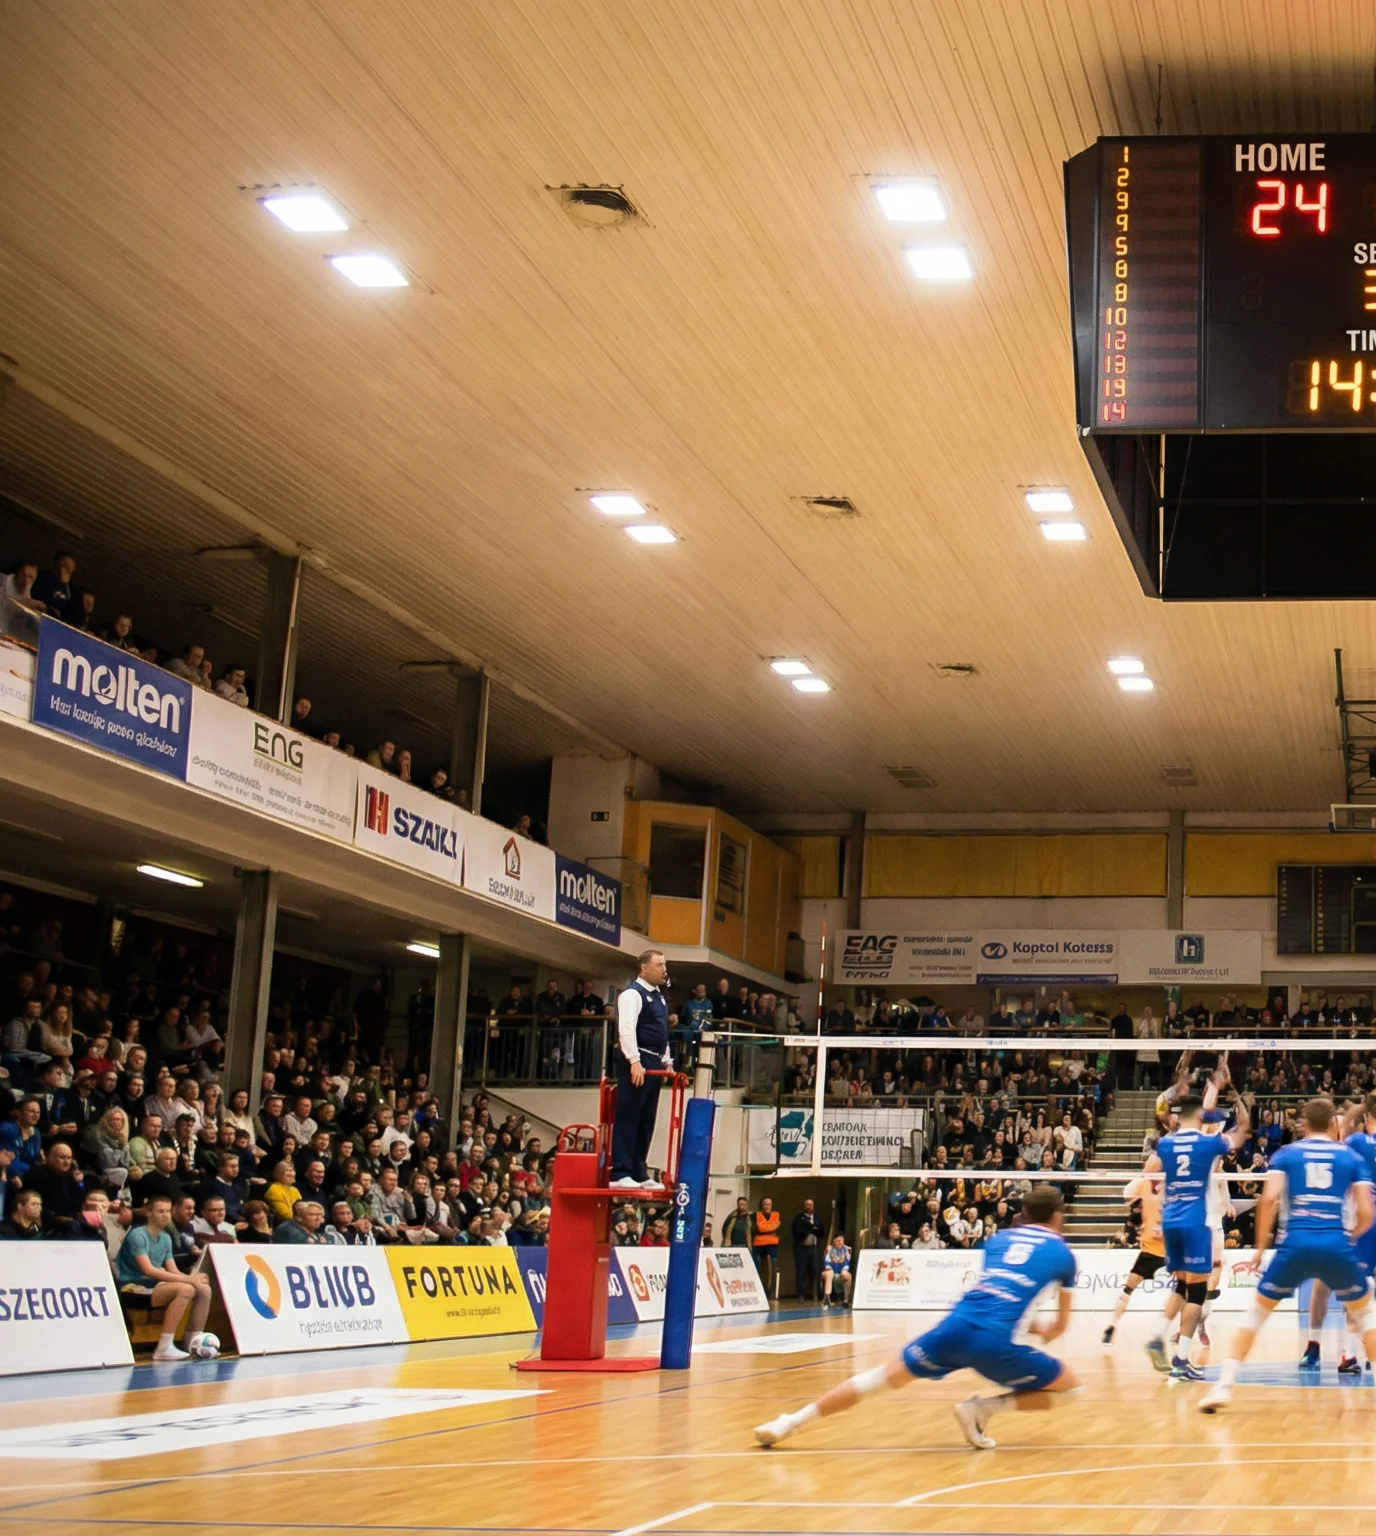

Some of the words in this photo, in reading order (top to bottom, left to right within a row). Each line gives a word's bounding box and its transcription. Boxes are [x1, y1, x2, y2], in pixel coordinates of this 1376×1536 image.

[1123, 146, 1129, 163] 1
[1235, 143, 1326, 172] HOME
[1117, 167, 1130, 187] 2
[1116, 191, 1129, 210] 9
[1252, 181, 1327, 235] 24
[1116, 213, 1129, 232] 9
[1115, 236, 1128, 256] 5
[1114, 282, 1128, 303] 8
[1105, 307, 1127, 326] 10
[1104, 330, 1127, 351] 12
[52, 648, 181, 734] molten
[560, 869, 615, 916] molten
[1176, 1154, 1191, 1177] 2
[402, 1264, 518, 1298] FORTUNA
